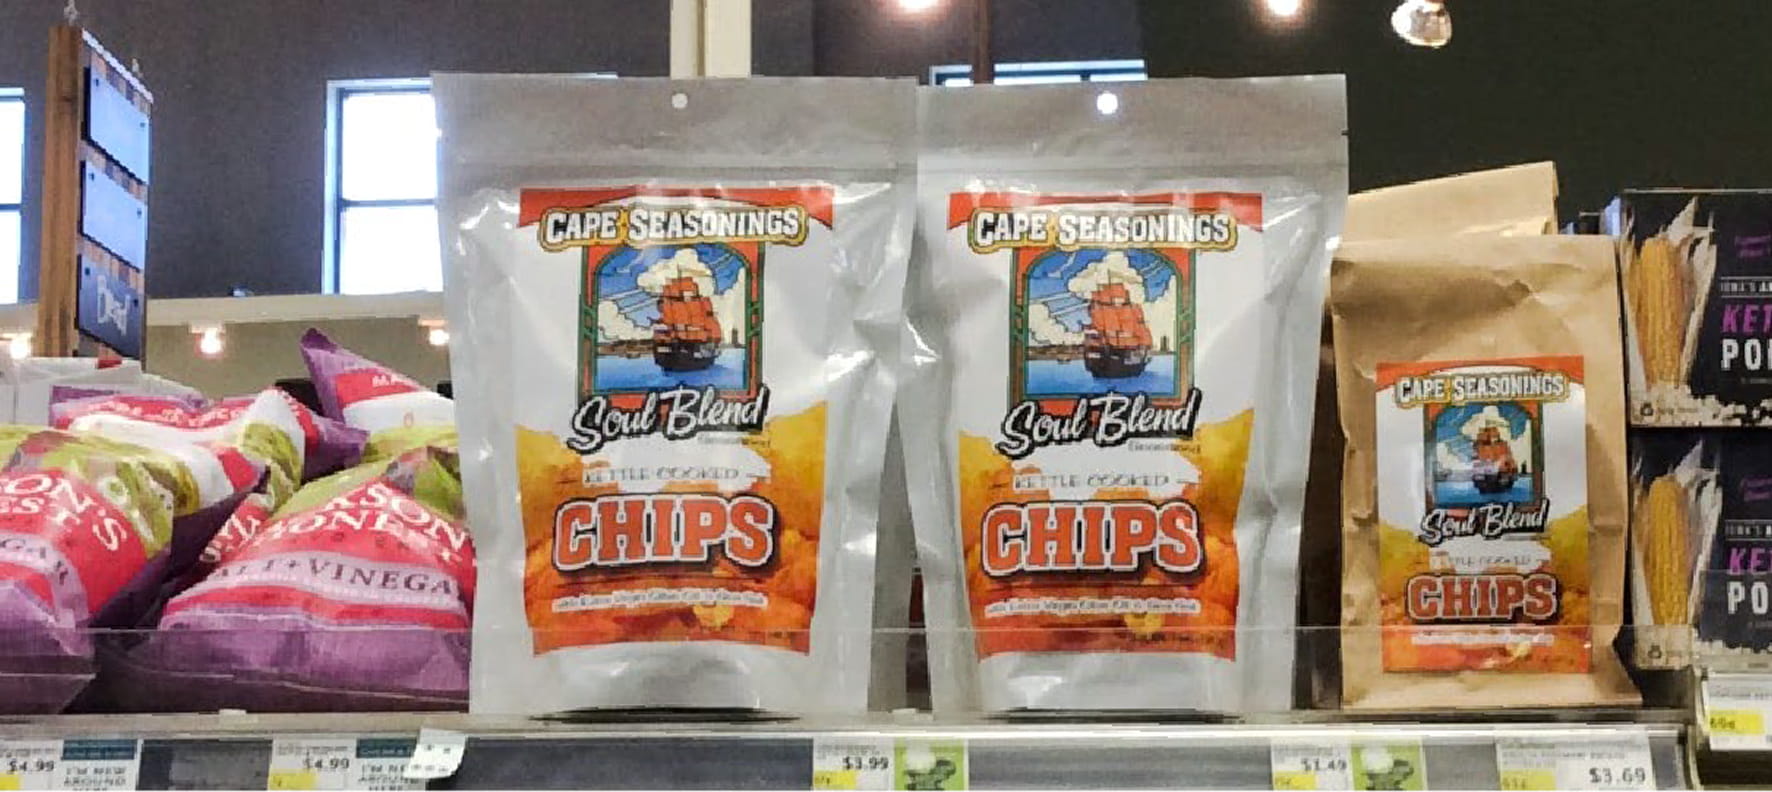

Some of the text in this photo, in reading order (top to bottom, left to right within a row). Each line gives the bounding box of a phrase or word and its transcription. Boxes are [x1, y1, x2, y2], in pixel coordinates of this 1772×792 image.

[546, 207, 800, 242] CAPE SEASONINGS
[976, 211, 1230, 245] CAPE SEASONINGS
[1398, 375, 1565, 403] CAPE SEASONINGS
[568, 386, 769, 452] Soul Blend
[997, 389, 1201, 457] Soul Blend
[0, 473, 128, 552] ON'S
[554, 494, 775, 570] CHIPS
[1418, 498, 1549, 545] Soul Blend
[982, 501, 1202, 576] CHIPS
[308, 556, 452, 595] VINEGA
[1727, 547, 1772, 575] KE
[1406, 574, 1558, 621] CHIPS
[303, 755, 350, 770] $4.99
[843, 755, 889, 770] $3.99
[1589, 767, 1646, 783] $3.69
